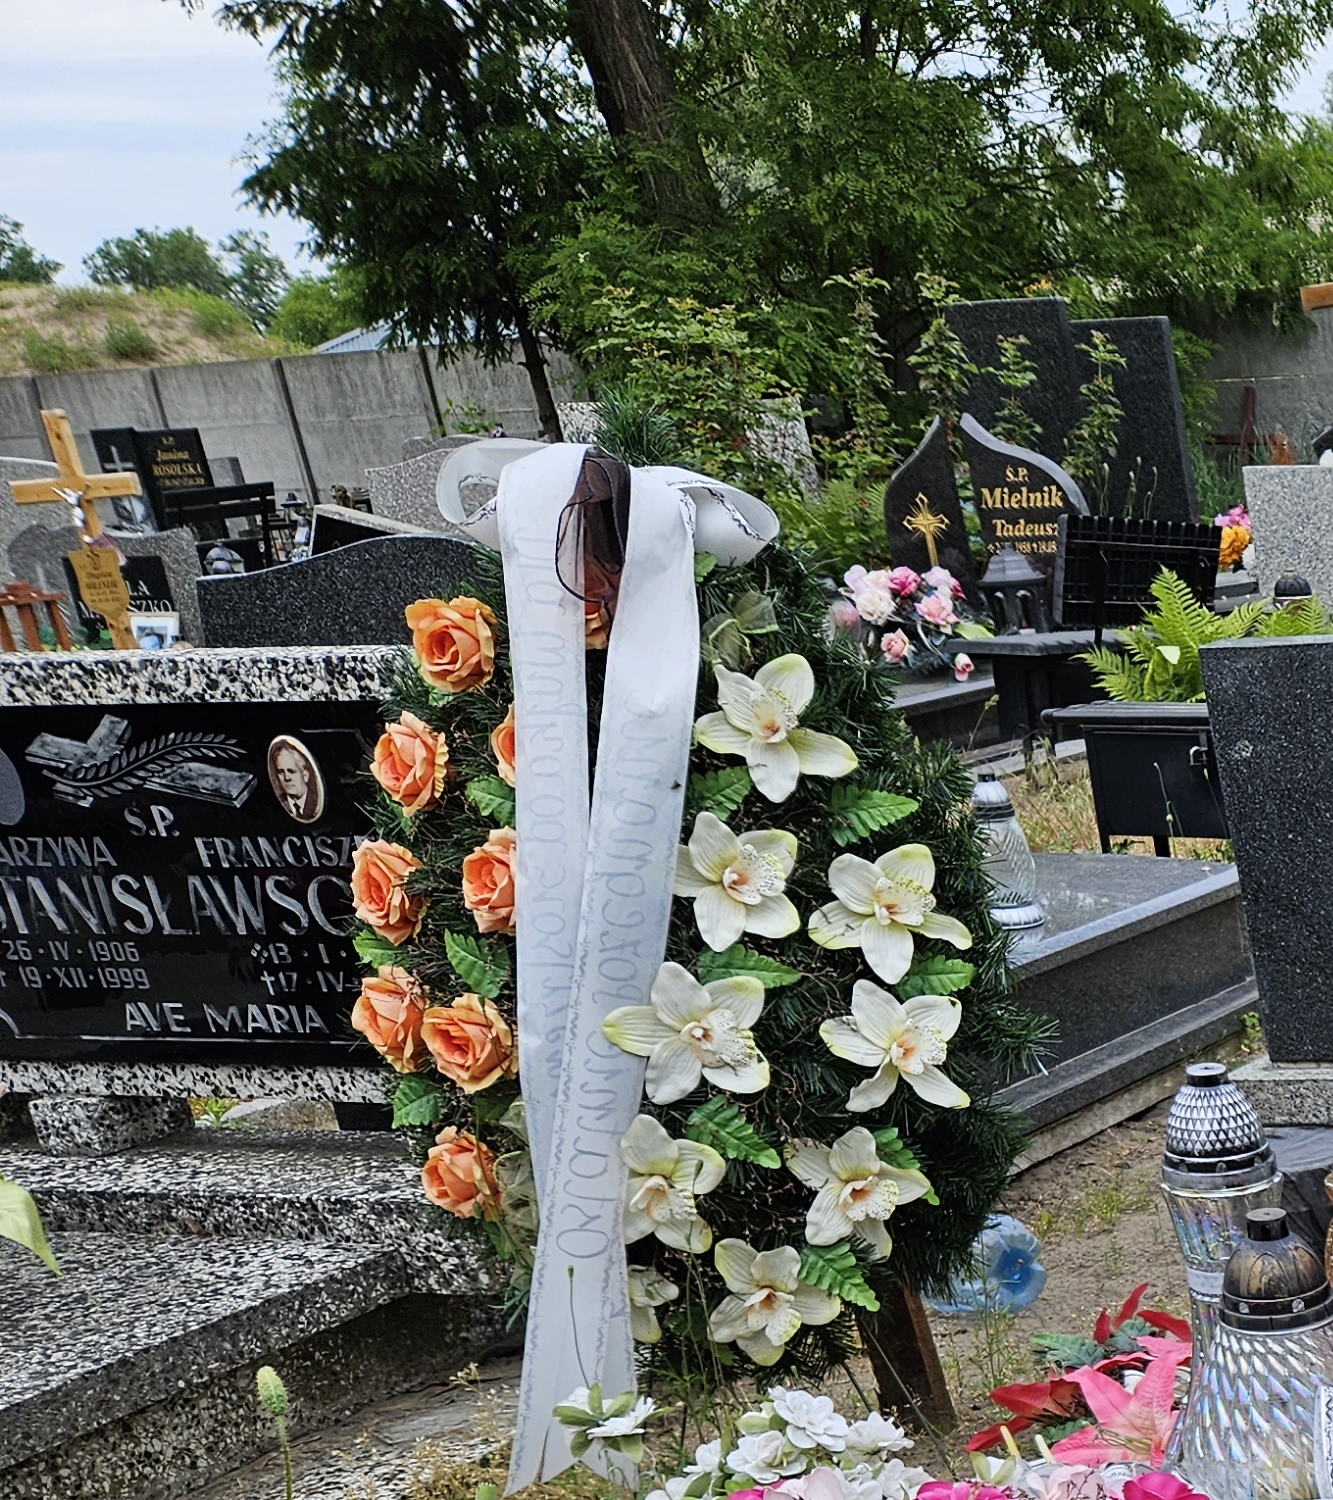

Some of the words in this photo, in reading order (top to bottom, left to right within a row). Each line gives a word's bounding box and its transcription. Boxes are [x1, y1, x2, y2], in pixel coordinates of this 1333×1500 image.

[1005, 464, 1031, 482] Ś.P.
[980, 485, 1064, 509] Mielnik
[194, 835, 376, 869] FRANCISZ
[125, 1001, 192, 1033] AVE
[202, 1003, 331, 1034] MARIA
